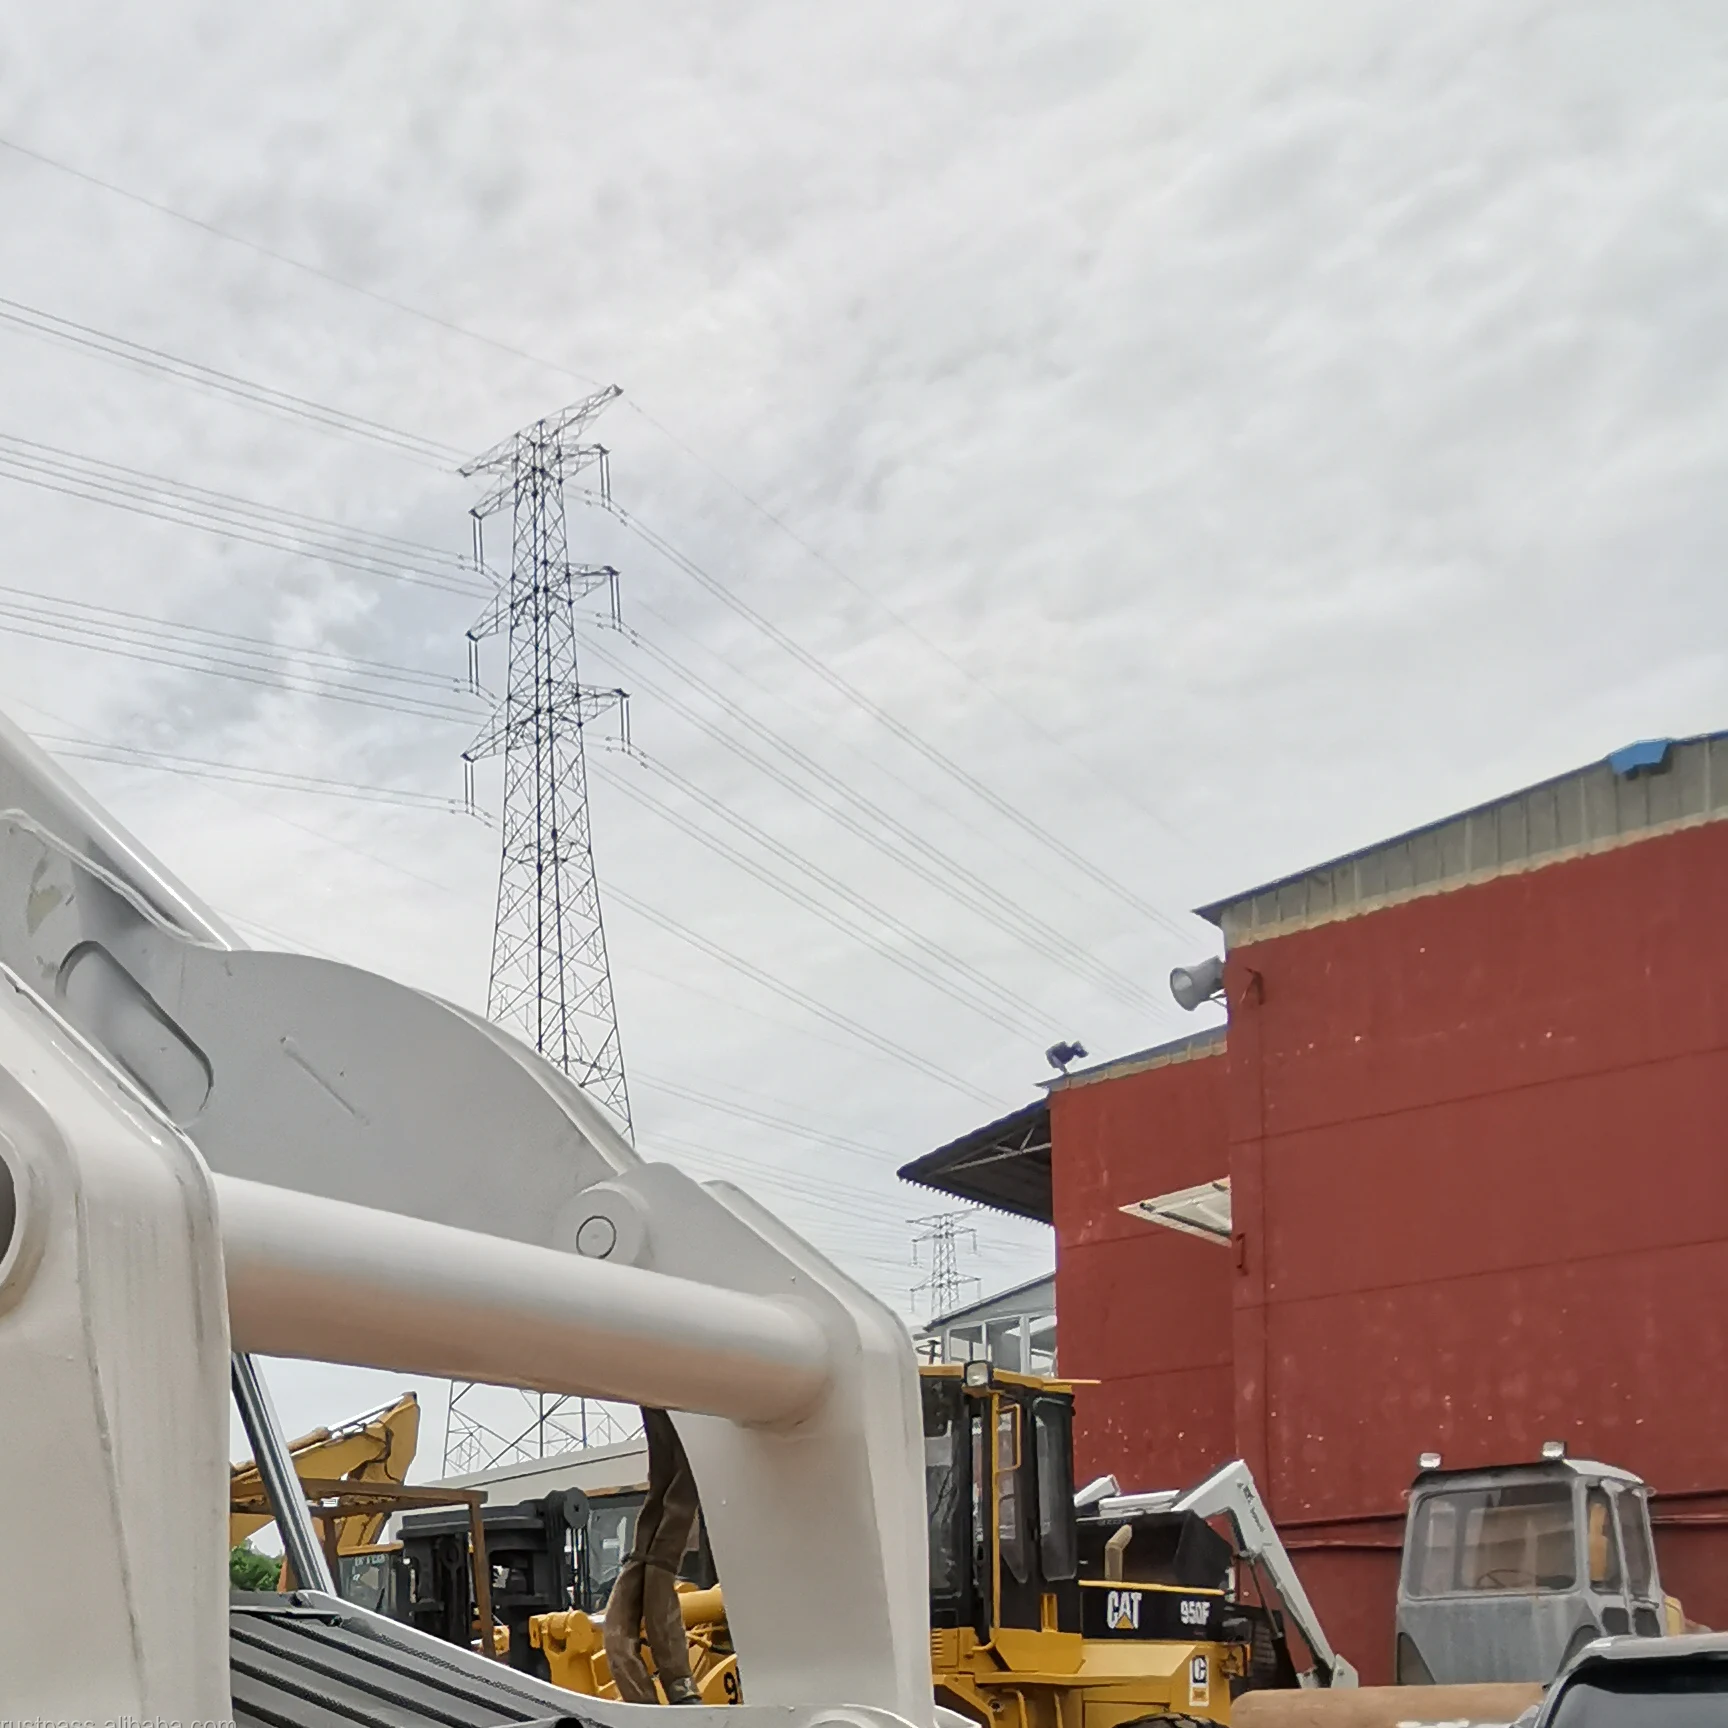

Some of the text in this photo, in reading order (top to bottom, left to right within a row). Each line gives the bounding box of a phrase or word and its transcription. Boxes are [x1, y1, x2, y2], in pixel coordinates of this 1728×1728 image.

[1106, 1590, 1142, 1630] CAT
[1180, 1600, 1211, 1626] 950F
[723, 1666, 742, 1705] 9
